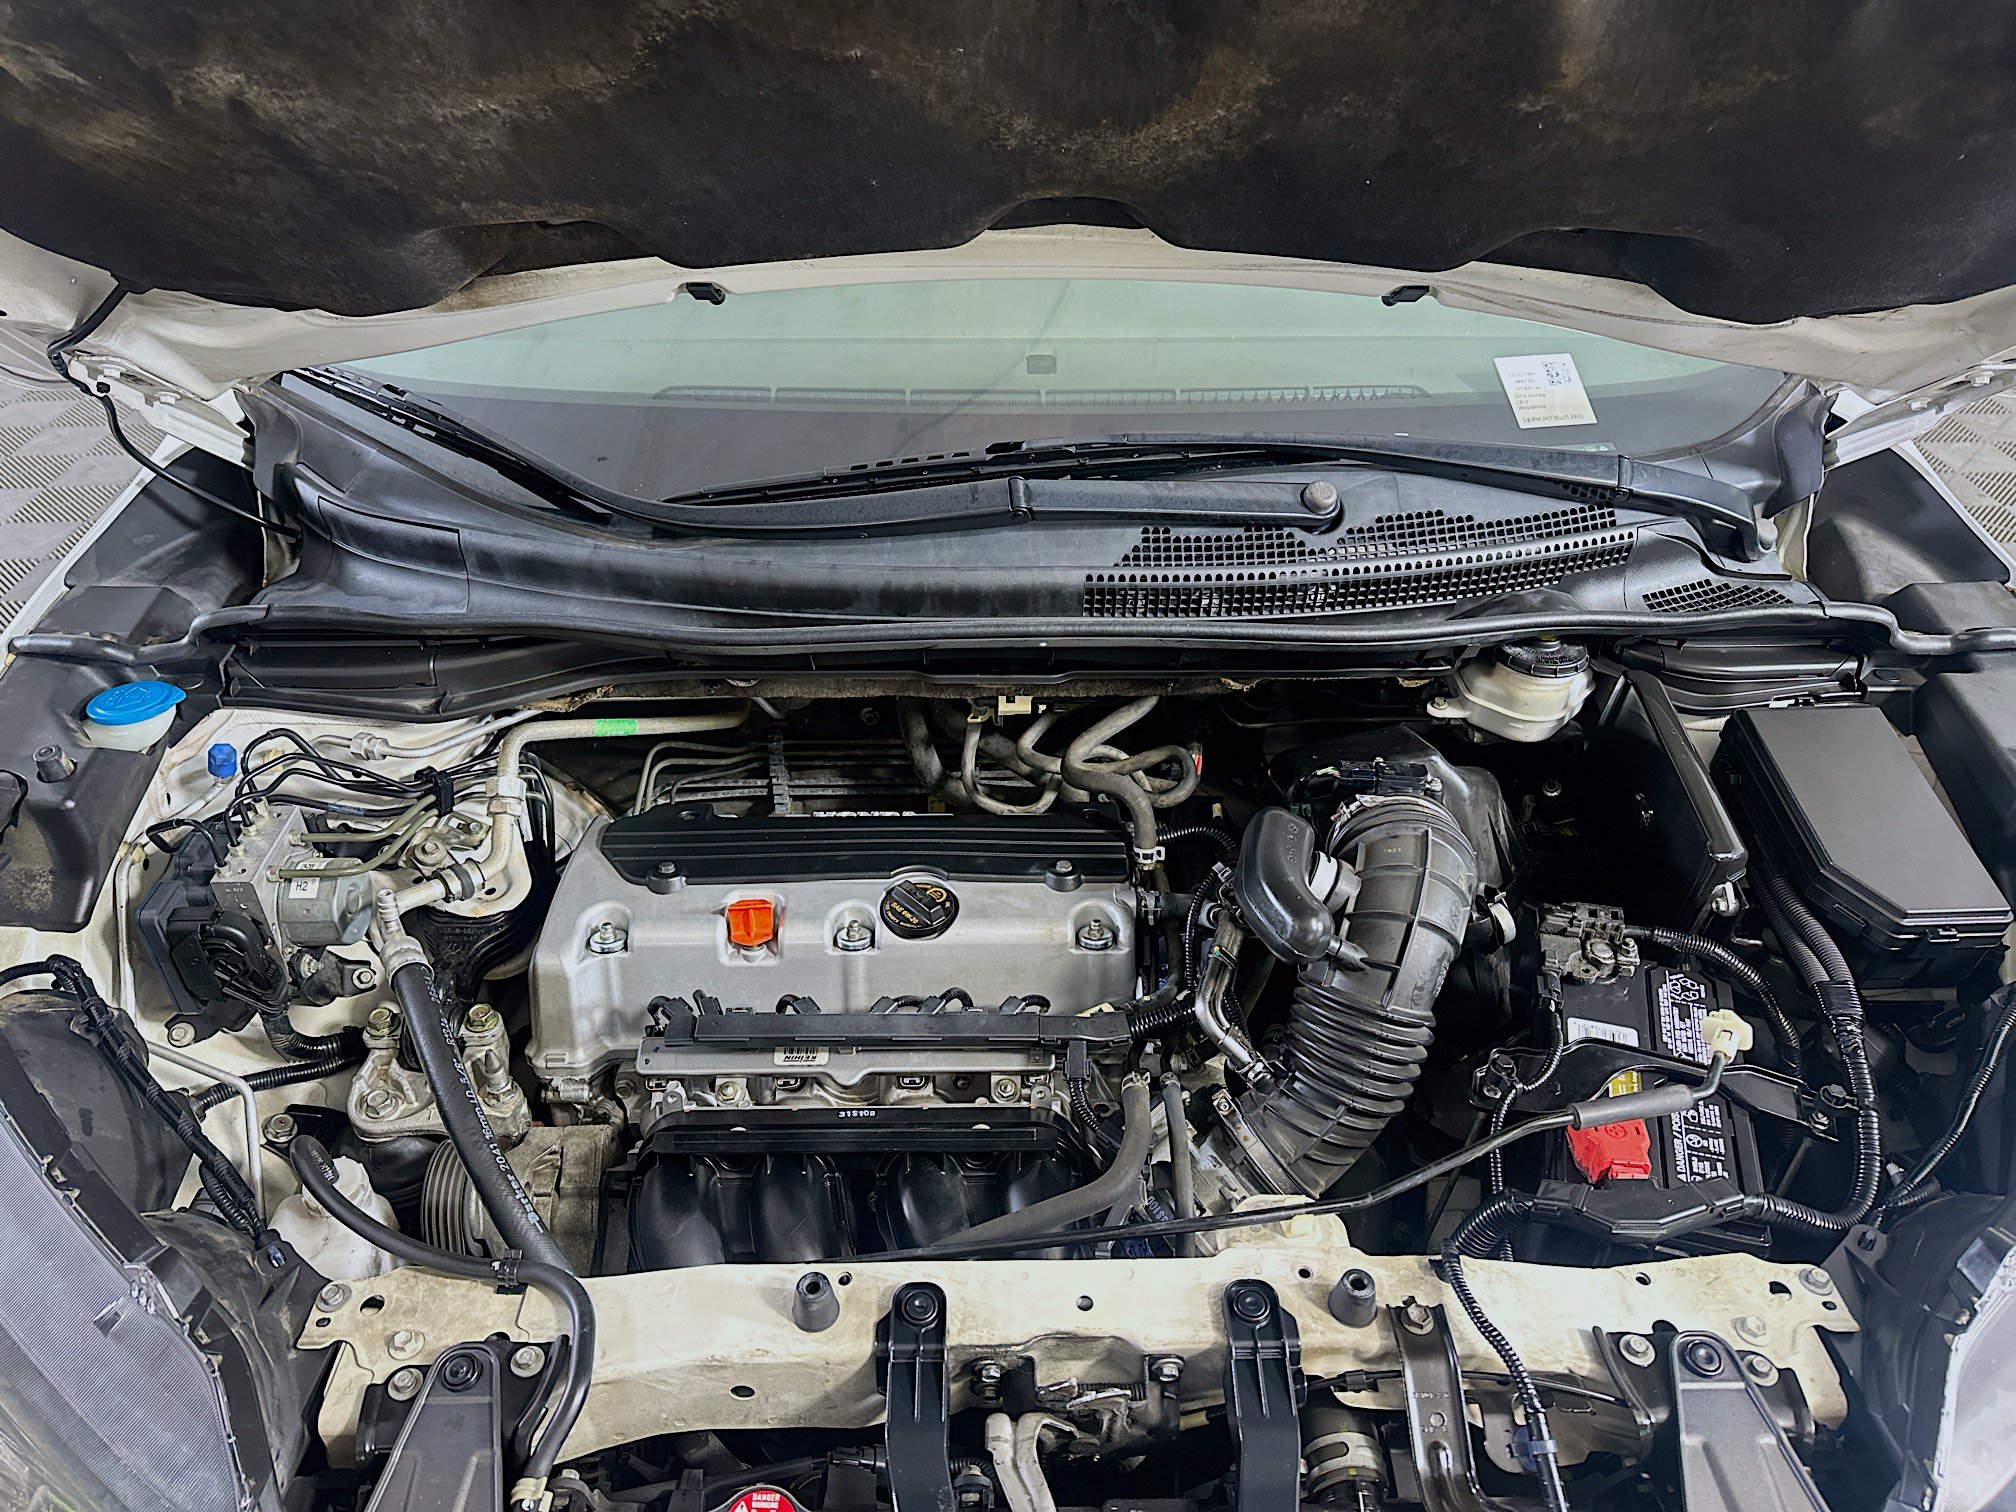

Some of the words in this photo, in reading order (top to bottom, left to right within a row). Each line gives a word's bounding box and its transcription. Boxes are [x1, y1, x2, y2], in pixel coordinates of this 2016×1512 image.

[296, 881, 308, 891] H2
[891, 902, 904, 913] SAE
[490, 1143, 509, 1171] 2041
[1674, 1138, 1686, 1174] DANGER
[752, 1493, 781, 1501] DANGER
